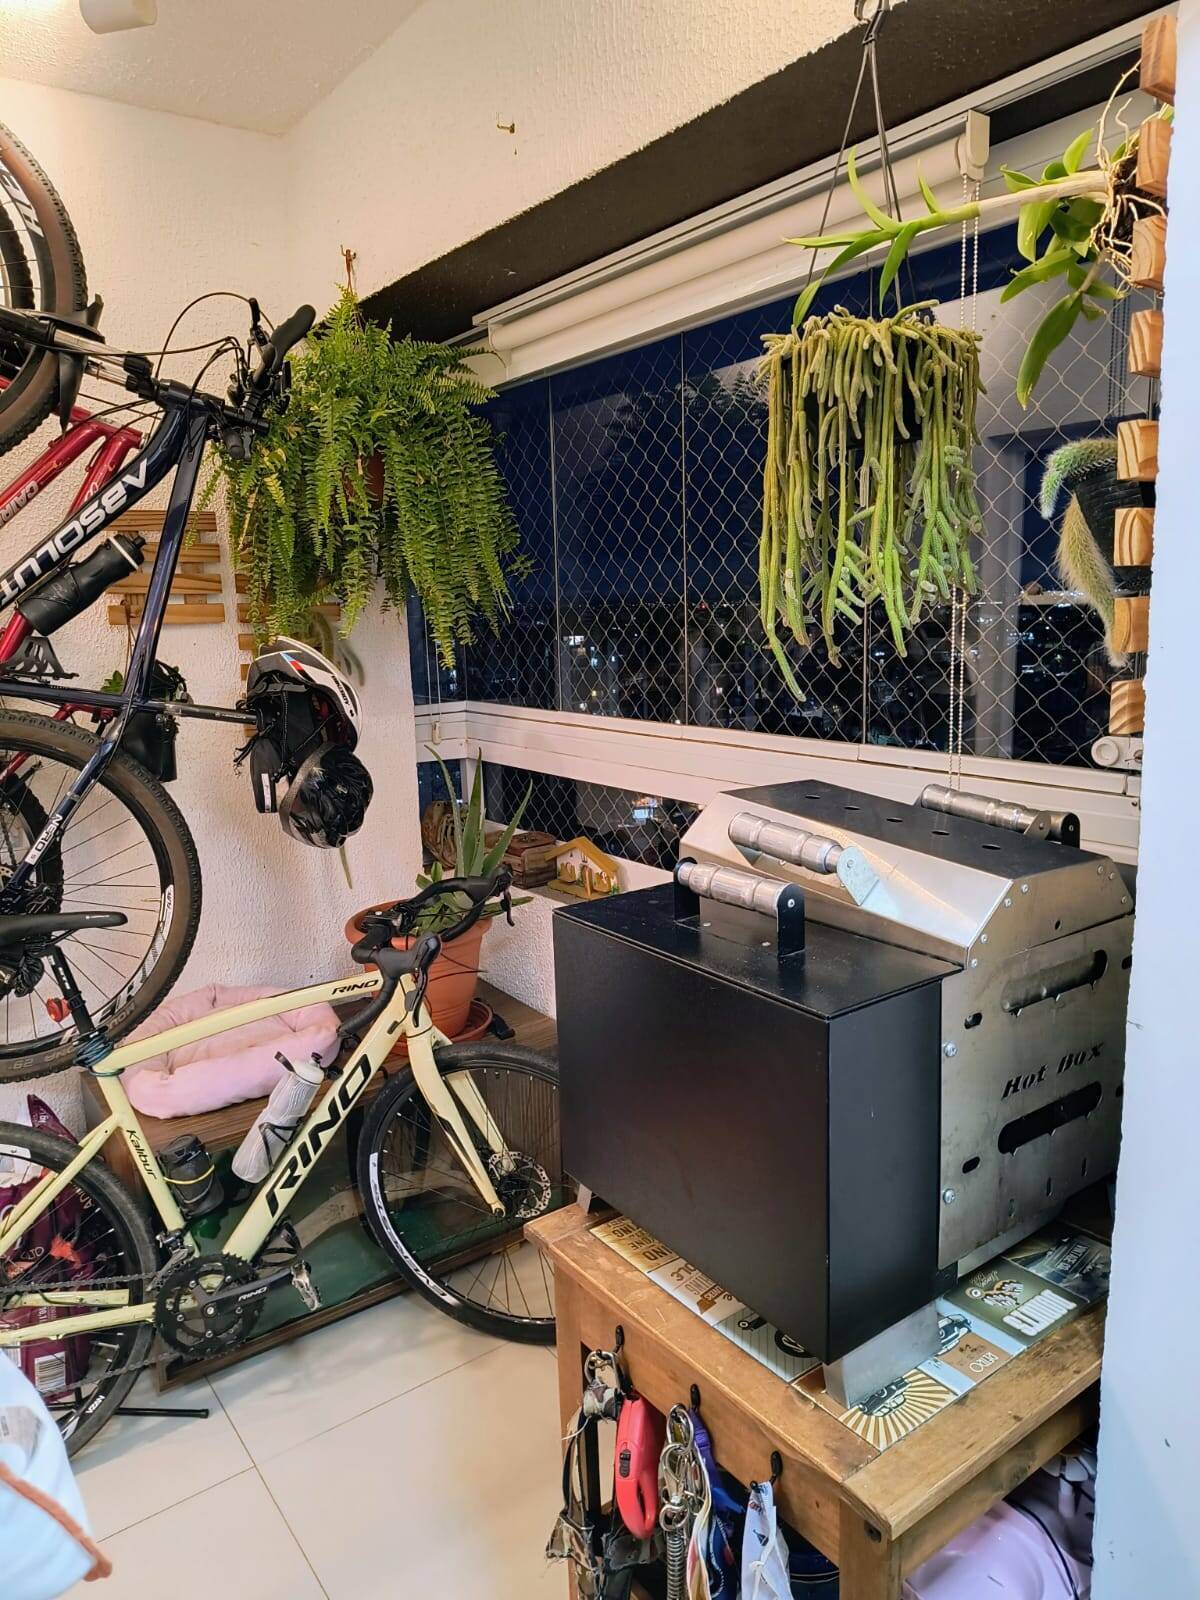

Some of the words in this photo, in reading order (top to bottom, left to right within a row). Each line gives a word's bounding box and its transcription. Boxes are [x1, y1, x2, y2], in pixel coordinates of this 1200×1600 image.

[34, 813, 63, 852] NERO
[332, 979, 379, 995] RINO
[1001, 1064, 1049, 1101] Hot
[1057, 1041, 1105, 1075] Box
[126, 1128, 157, 1180] Kalibur
[265, 1053, 372, 1218] RINO
